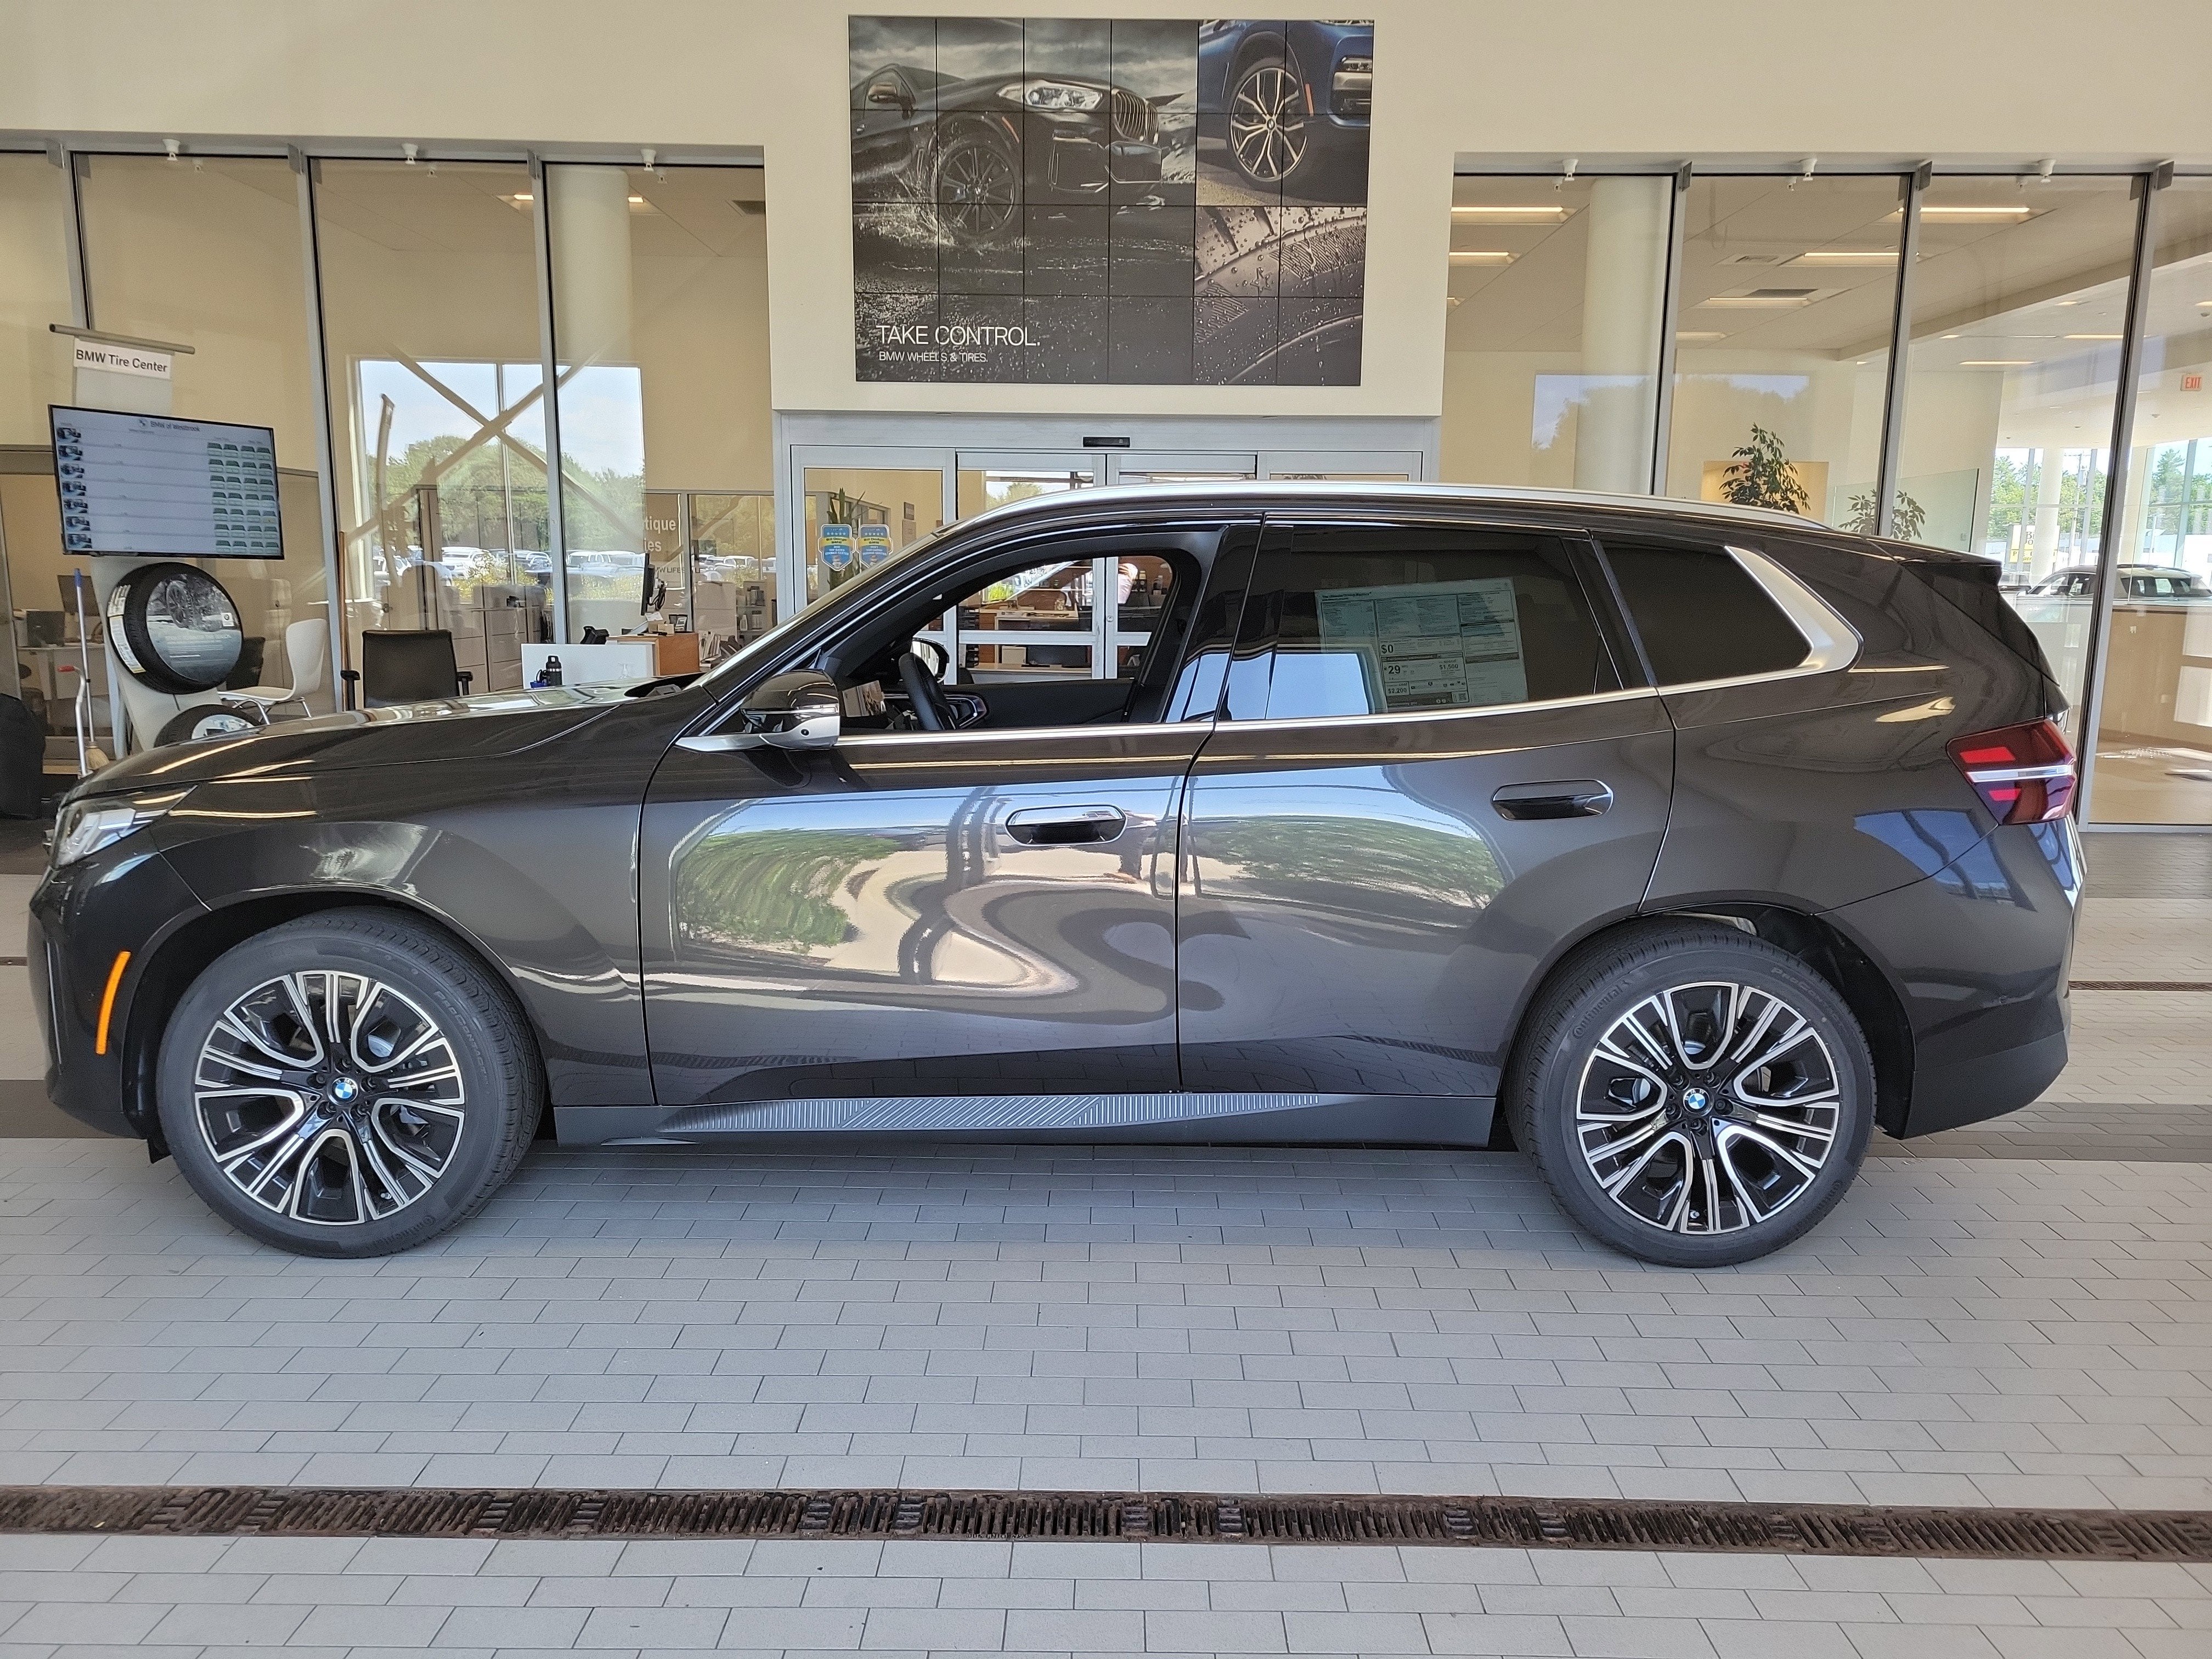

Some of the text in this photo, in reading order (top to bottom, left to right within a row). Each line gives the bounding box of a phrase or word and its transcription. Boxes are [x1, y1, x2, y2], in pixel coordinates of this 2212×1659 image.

[876, 325, 1040, 346] TAKE CONTROL.
[76, 349, 167, 372] BMW Tire Center
[879, 351, 905, 361] BMW
[907, 352, 947, 362] WHEELS
[960, 353, 988, 362] TIRES.
[2186, 376, 2202, 389] EXIT
[644, 516, 676, 534] tique
[644, 538, 662, 552] ies
[1381, 645, 1393, 654] $0
[1388, 665, 1401, 674] 29
